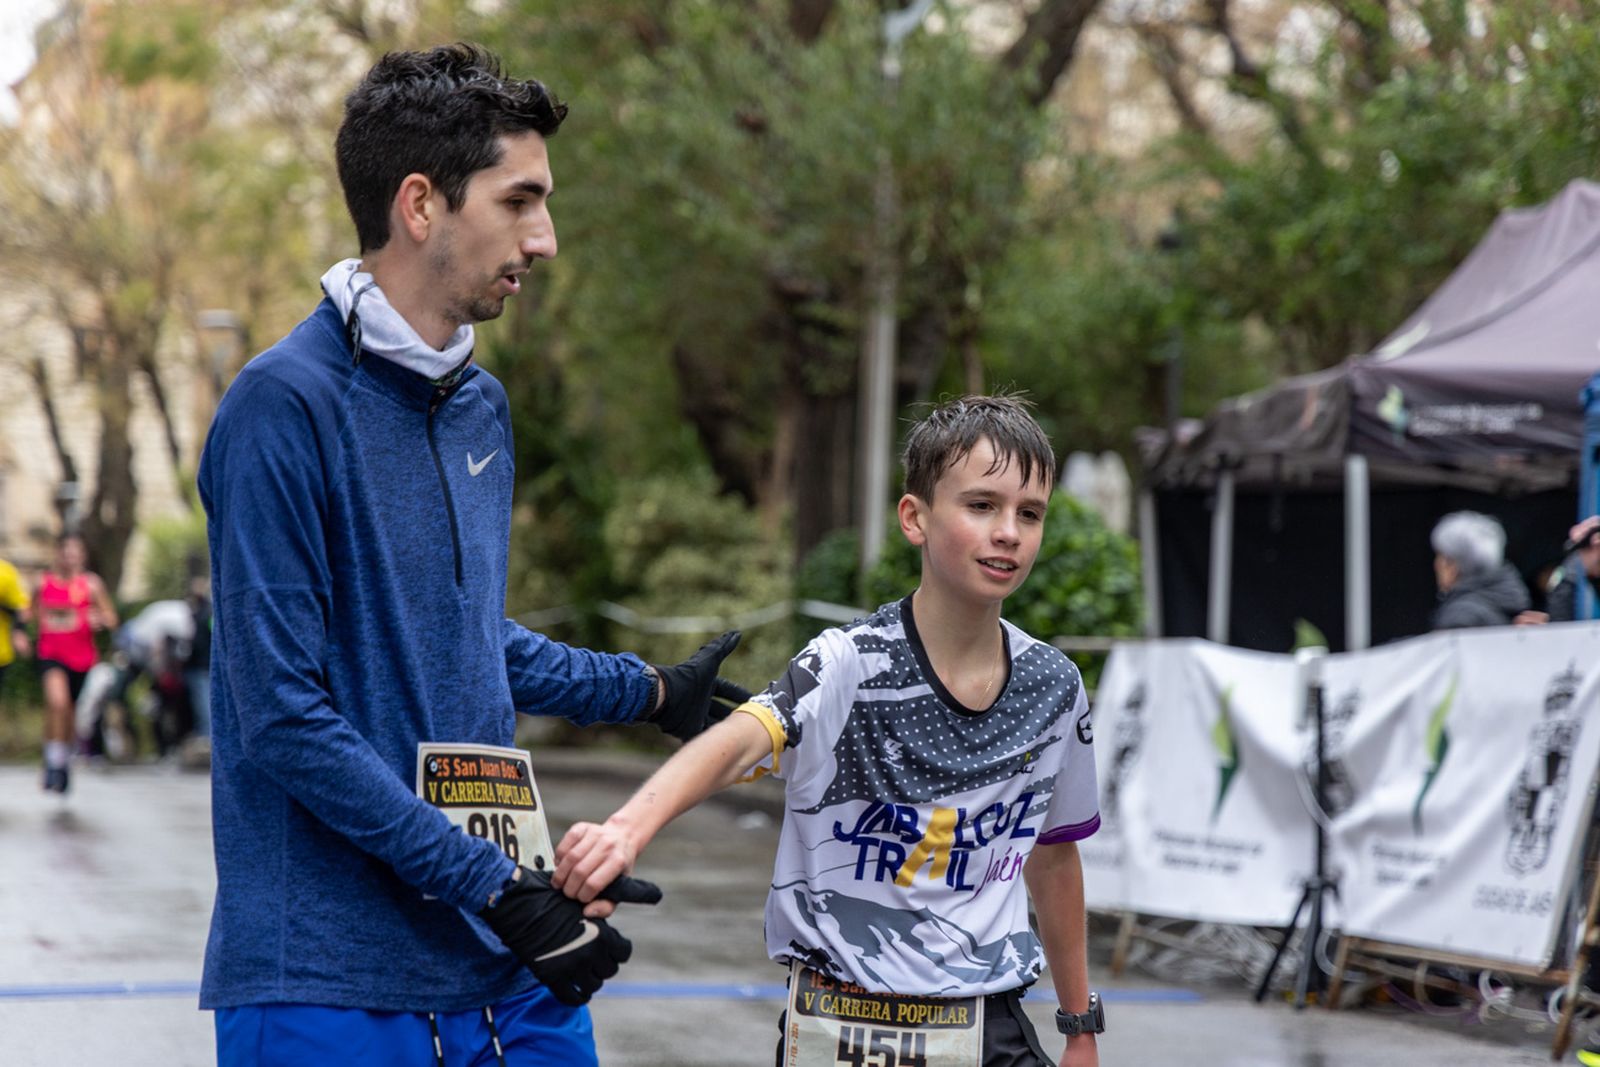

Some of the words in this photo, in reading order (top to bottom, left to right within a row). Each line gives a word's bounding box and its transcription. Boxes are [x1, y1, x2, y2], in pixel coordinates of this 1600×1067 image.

[436, 757, 451, 778] ES
[453, 757, 478, 777] San
[480, 758, 500, 777] Juan
[428, 782, 438, 804] V
[441, 780, 497, 804] CARRERA
[495, 783, 534, 806] POPULAR
[851, 836, 975, 892] TRAIL
[968, 846, 1023, 902] Jaén
[804, 991, 815, 1011] V
[819, 993, 891, 1021] CARRERA
[897, 1003, 968, 1025] POPULAR
[837, 1025, 927, 1067] 454
